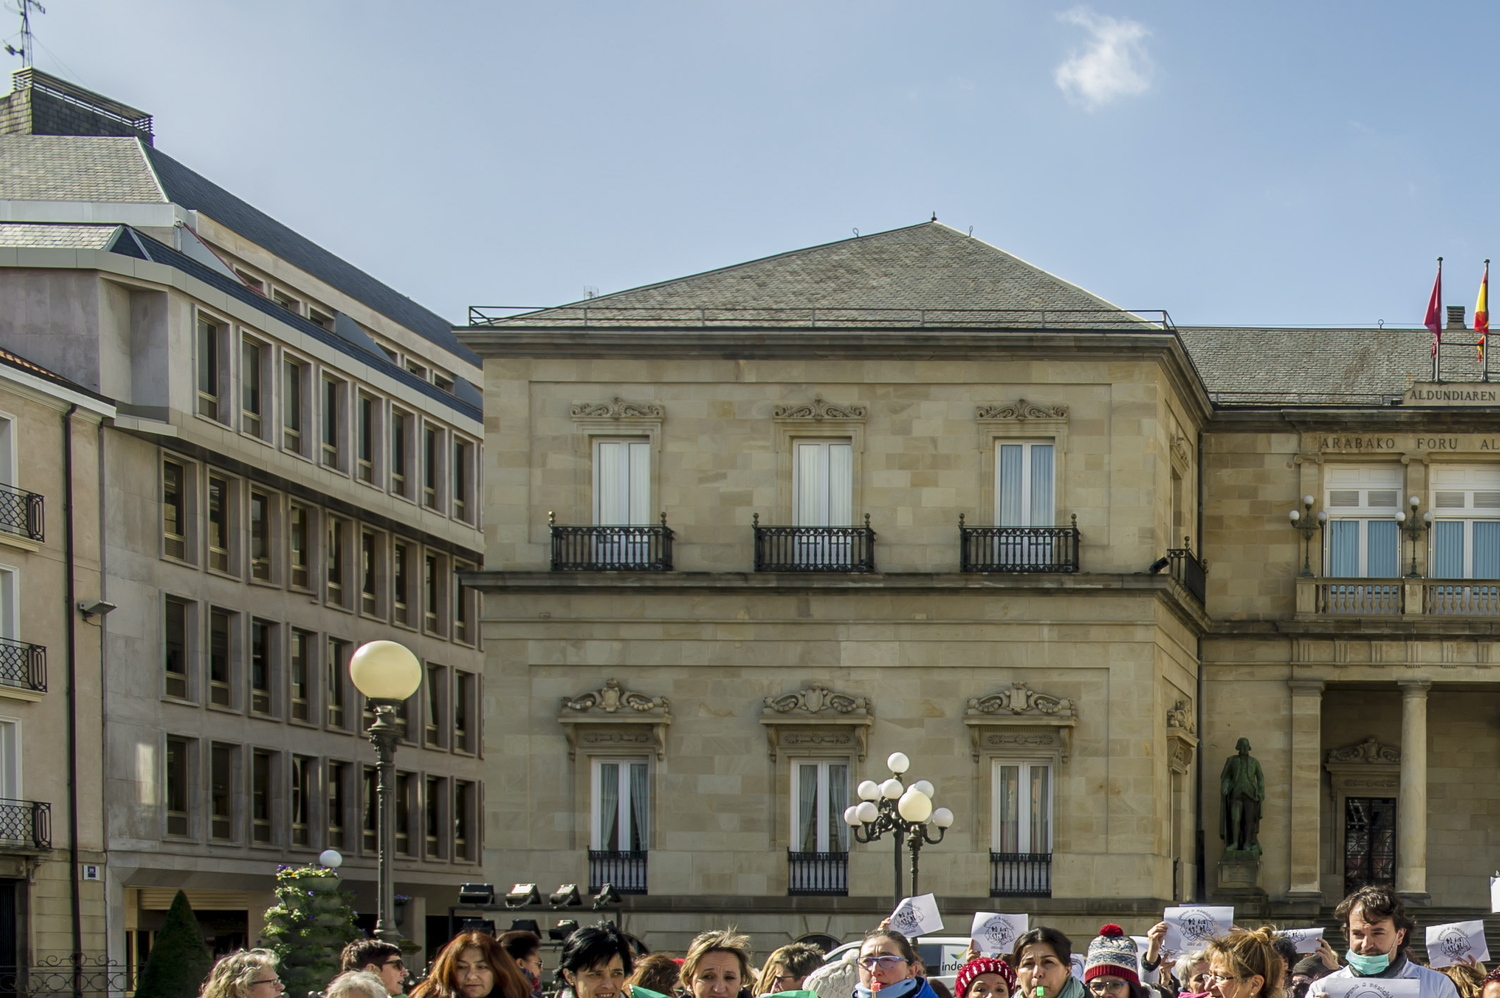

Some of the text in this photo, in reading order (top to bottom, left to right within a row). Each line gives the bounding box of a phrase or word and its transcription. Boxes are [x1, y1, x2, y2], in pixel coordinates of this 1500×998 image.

[1409, 390, 1496, 401] ALDUNDIAREN
[1321, 438, 1395, 449] ARABAKO
[1417, 438, 1458, 449] FORU
[941, 961, 963, 972] inde
